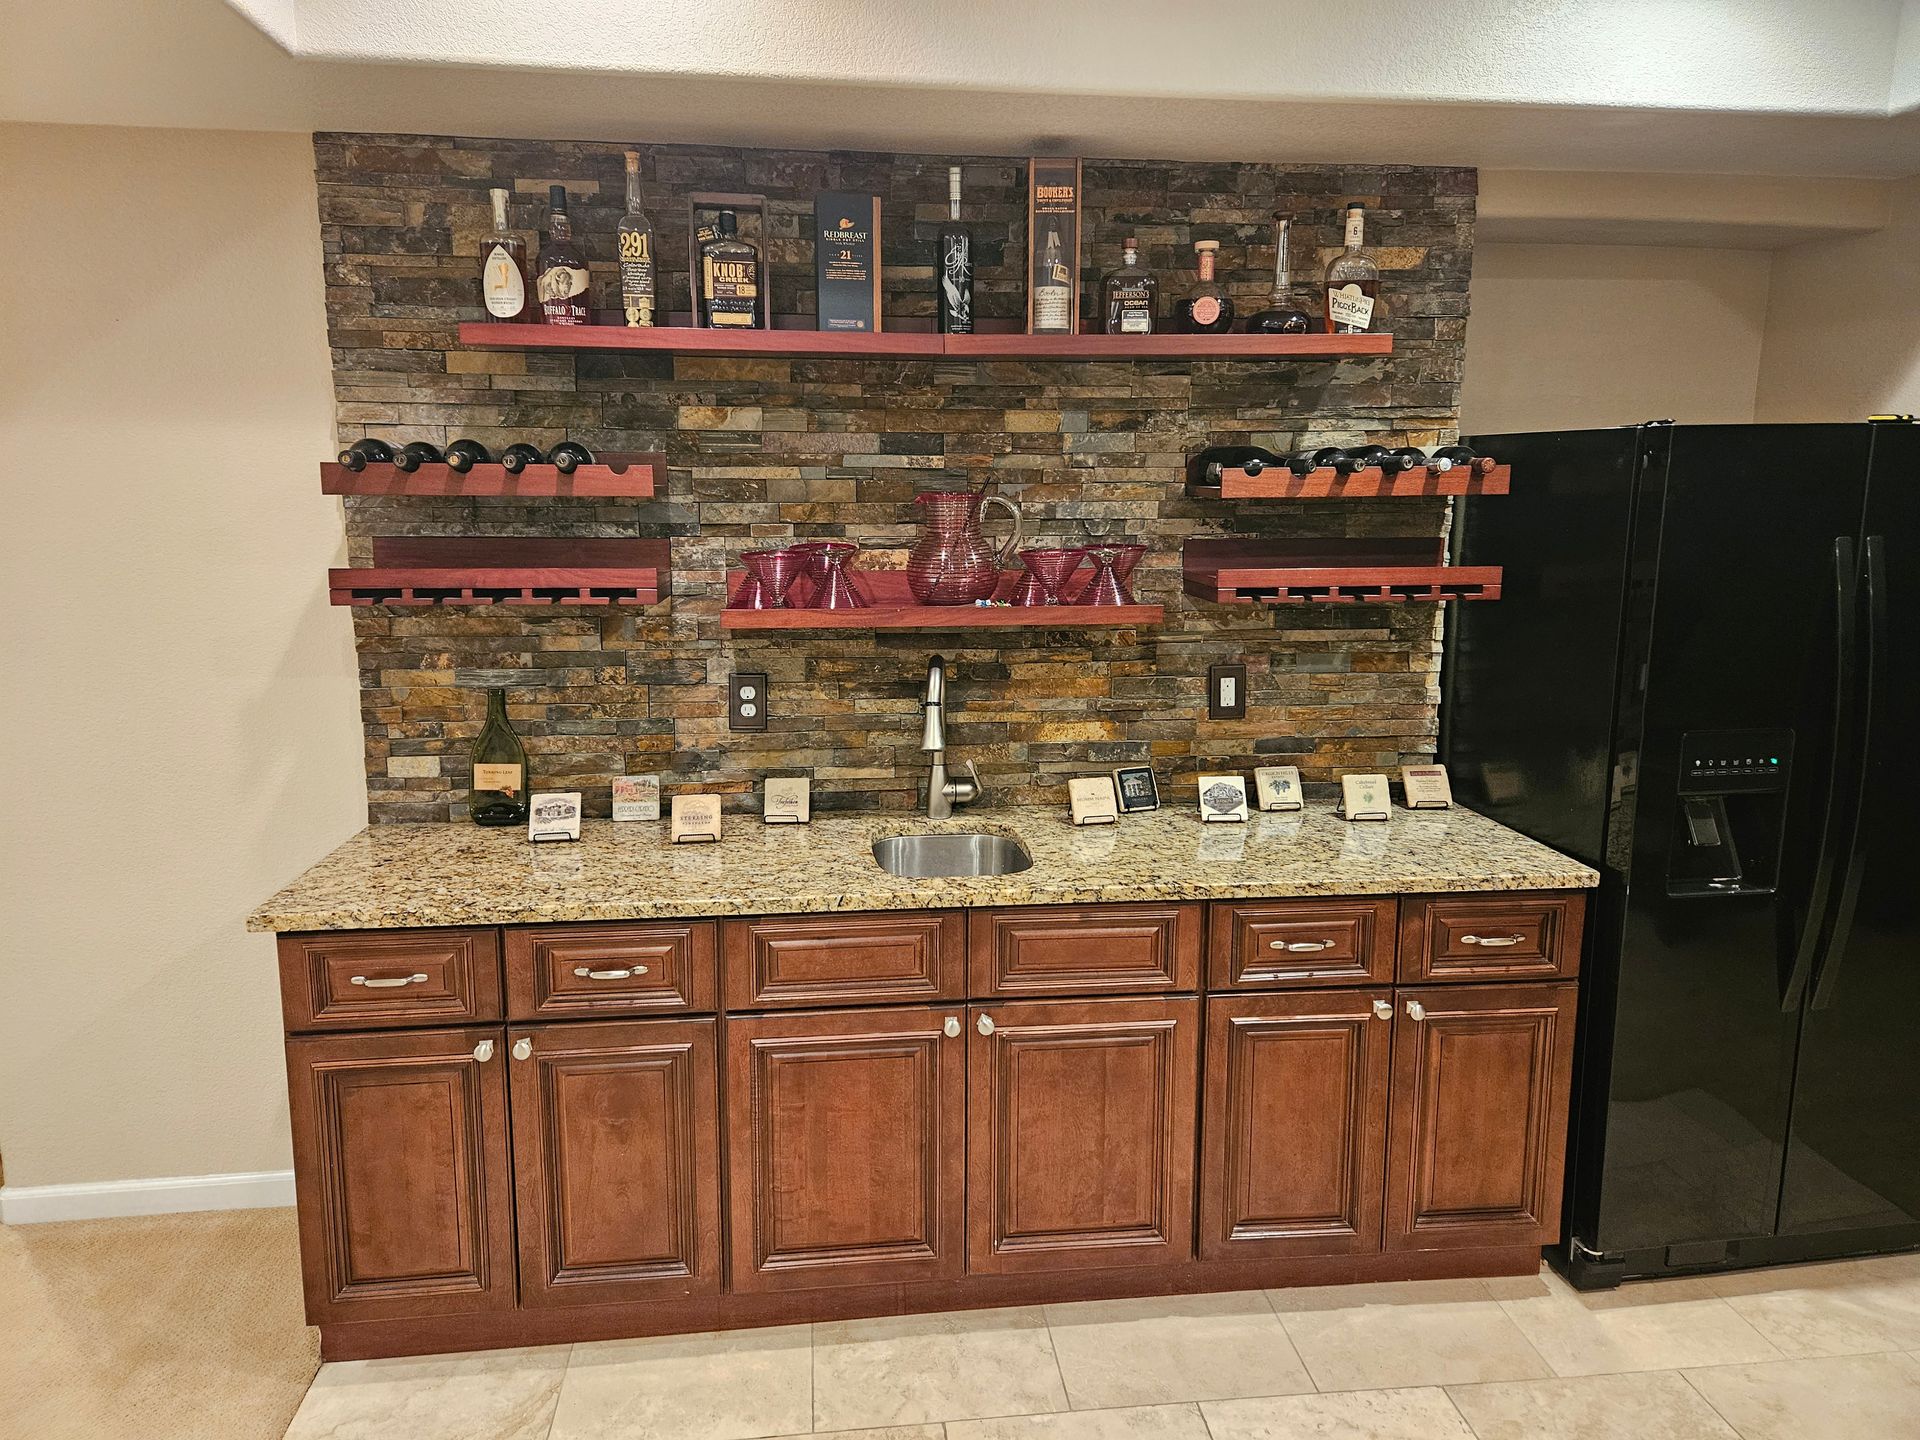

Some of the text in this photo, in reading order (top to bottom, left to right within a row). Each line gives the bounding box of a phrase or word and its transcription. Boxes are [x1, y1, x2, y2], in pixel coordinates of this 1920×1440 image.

[1037, 186, 1074, 198] BOOKER'S
[823, 230, 867, 240] REDBREAST
[1353, 226, 1358, 236] 6
[620, 231, 649, 259] 291
[840, 250, 852, 260] 21
[713, 262, 743, 278] KNOB
[738, 286, 746, 295] 18
[1112, 290, 1149, 300] JEFFERSON'S
[544, 304, 586, 316] BUFFALO TRACE
